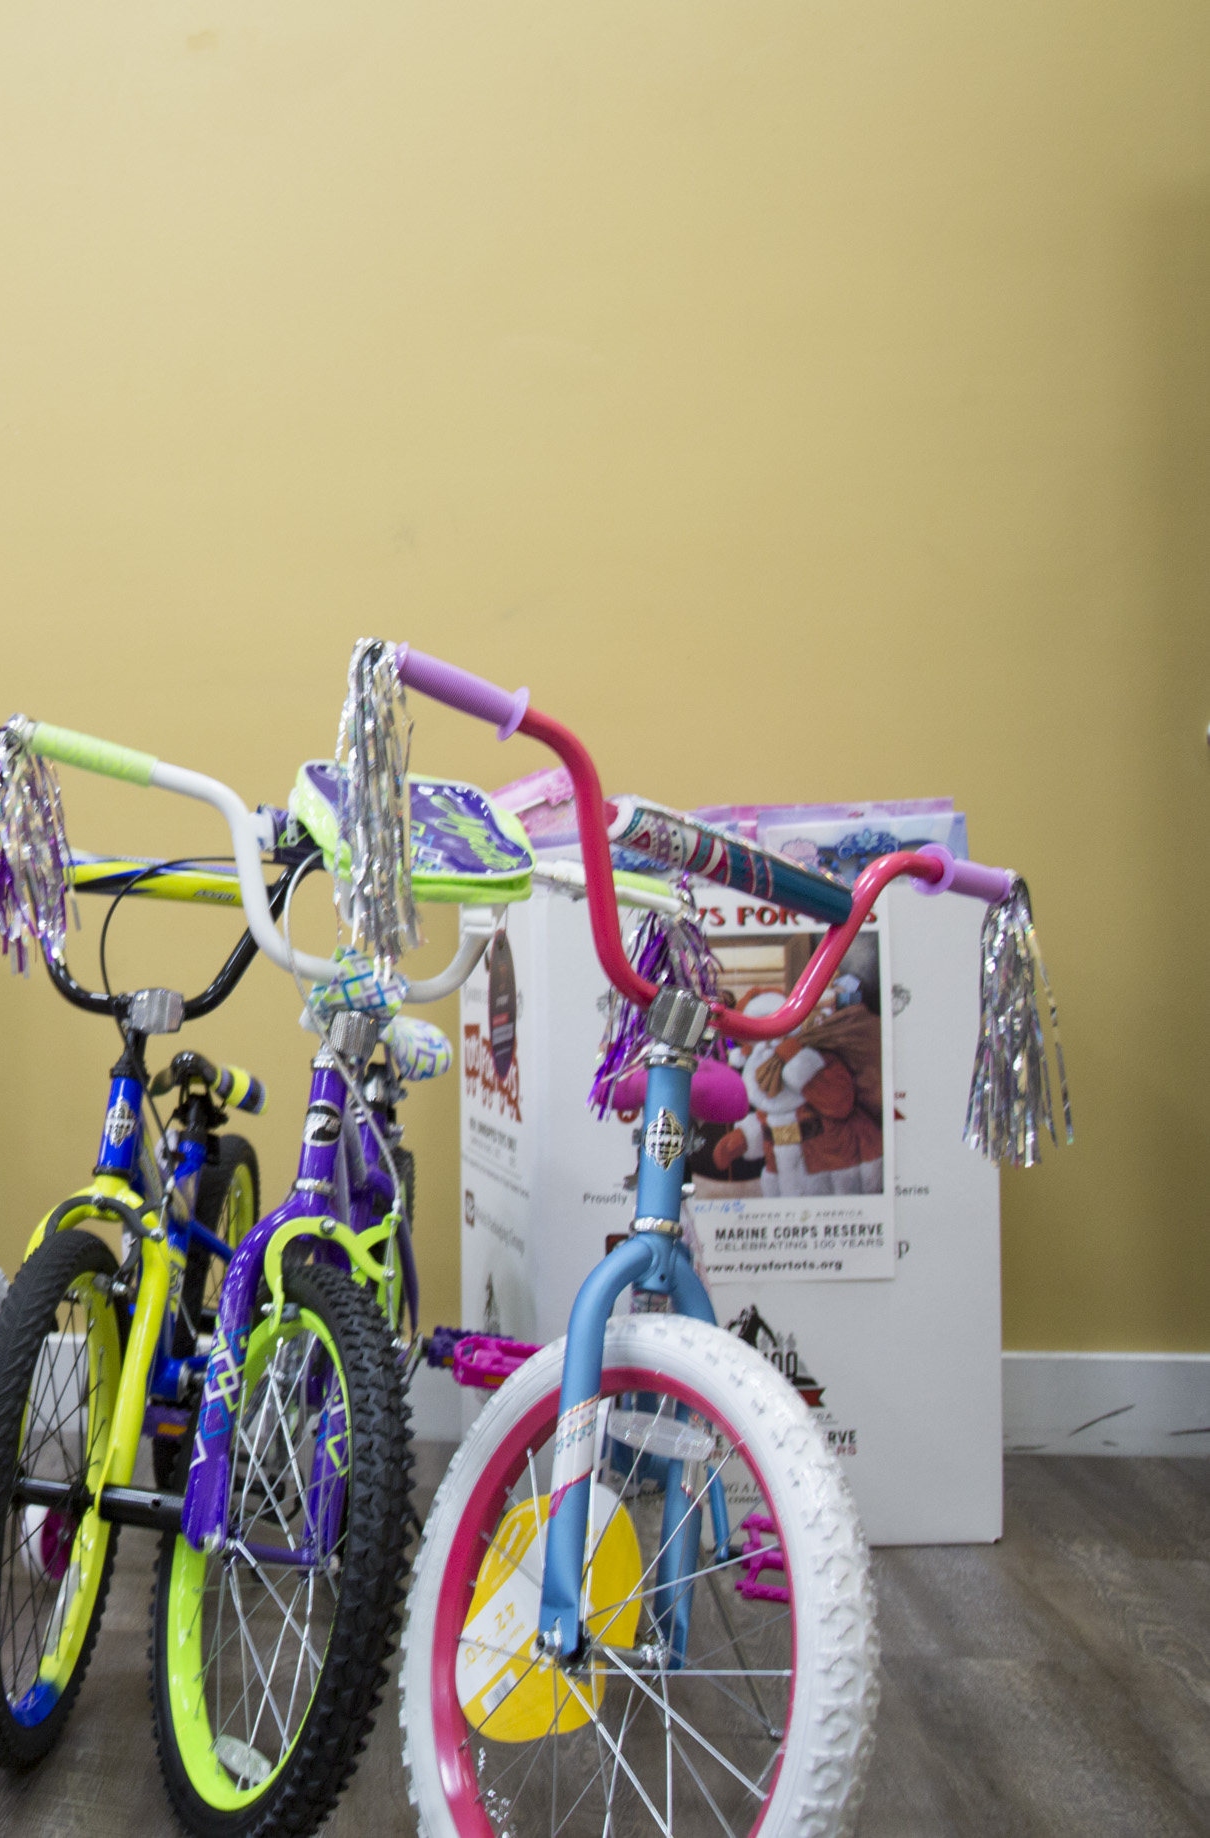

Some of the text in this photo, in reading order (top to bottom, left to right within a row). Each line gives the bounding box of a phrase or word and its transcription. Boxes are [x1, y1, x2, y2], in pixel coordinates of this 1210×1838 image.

[583, 1193, 628, 1205] Proudly
[894, 1185, 930, 1197] Series
[715, 1223, 884, 1241] MARINE CORPS RESERVE
[714, 1237, 884, 1253] CELEBRATING 100 YEARS
[763, 1351, 798, 1379] 00
